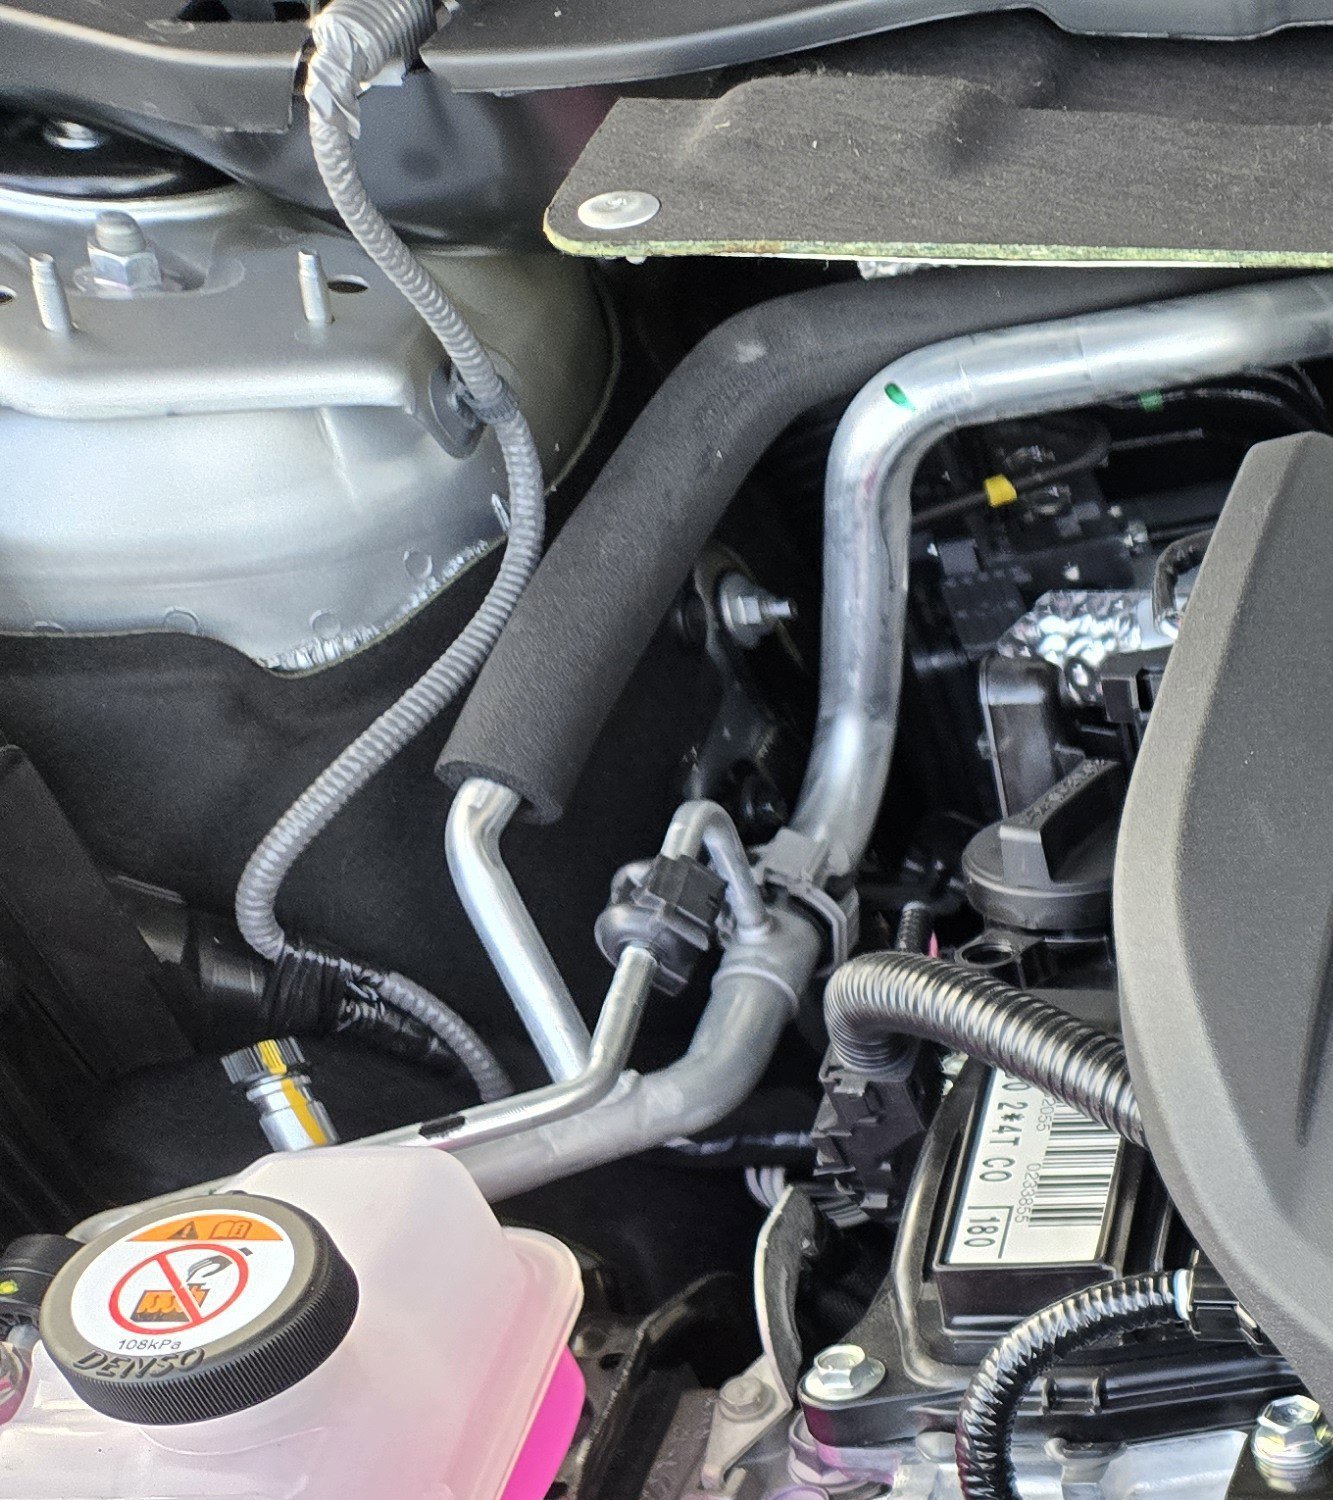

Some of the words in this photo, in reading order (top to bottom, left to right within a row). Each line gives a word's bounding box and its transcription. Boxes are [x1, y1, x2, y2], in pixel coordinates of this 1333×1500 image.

[1001, 1075, 1031, 1092] 0
[1035, 1094, 1057, 1132] 2055
[1013, 1163, 1042, 1224] 0233855
[963, 1216, 1002, 1249] 180
[117, 1339, 184, 1351] 108kPa
[72, 1346, 206, 1379] DENSO
